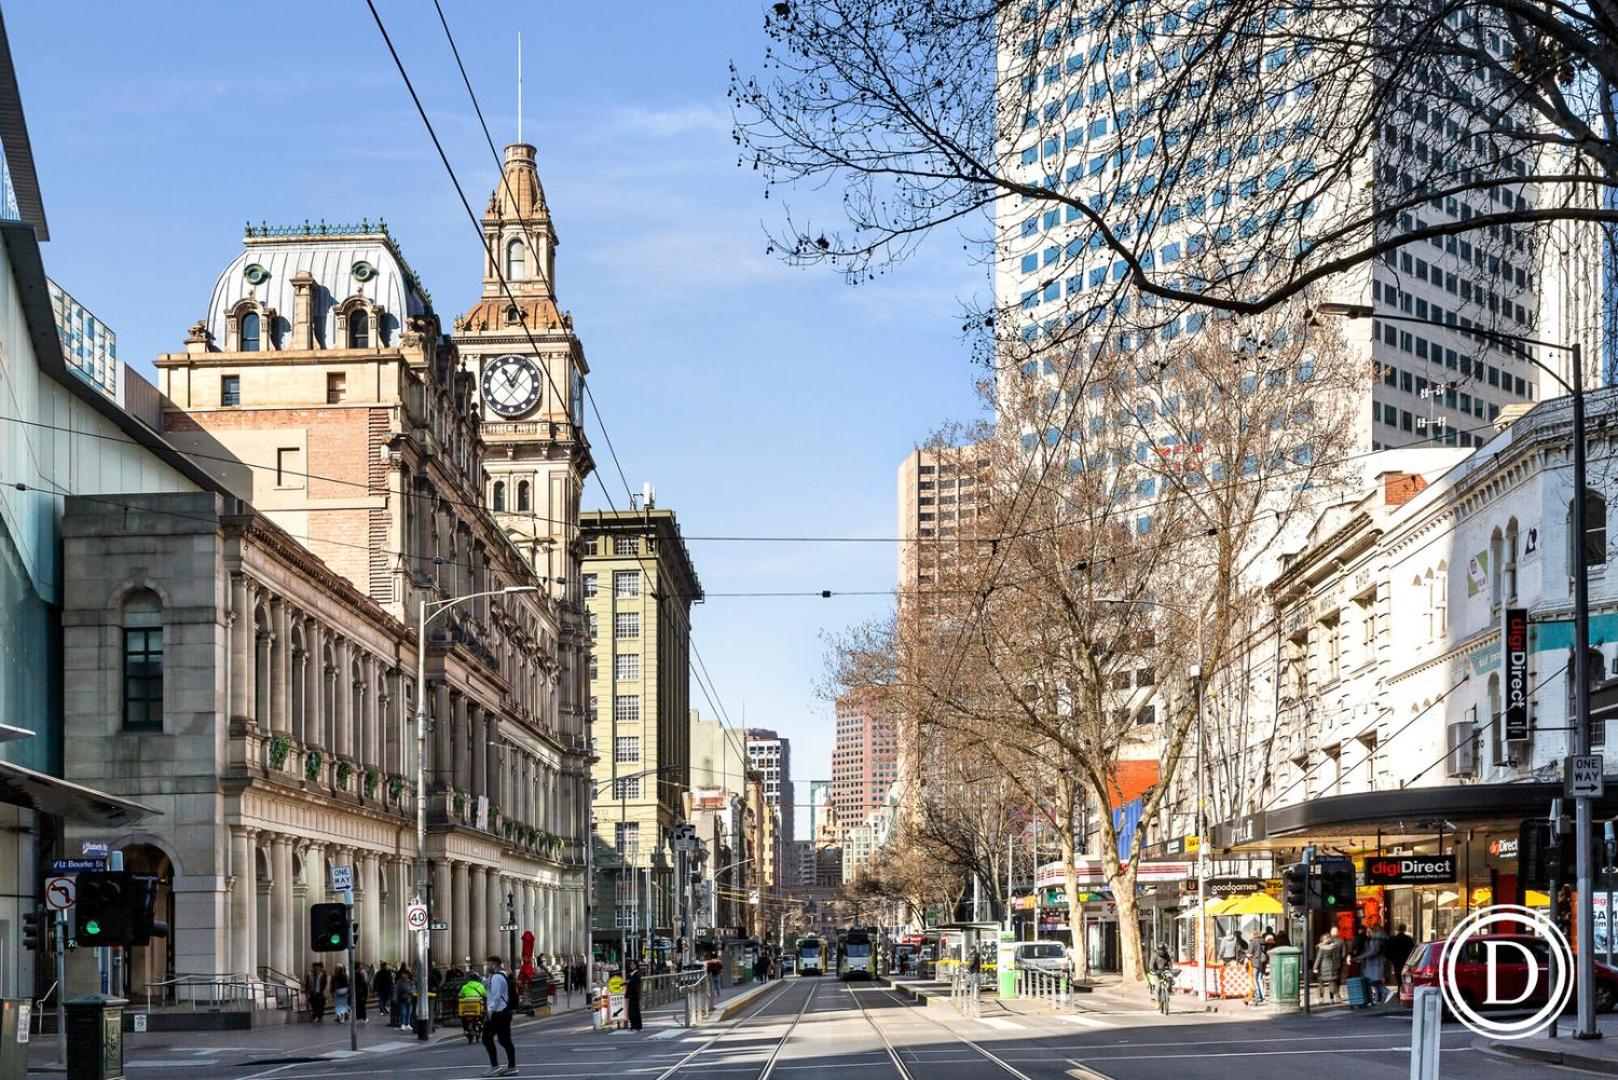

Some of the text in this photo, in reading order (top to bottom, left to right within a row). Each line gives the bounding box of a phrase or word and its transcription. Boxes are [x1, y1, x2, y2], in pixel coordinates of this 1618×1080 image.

[1508, 617, 1526, 709] digiDirect
[1576, 759, 1598, 769] ONE
[1574, 772, 1599, 781] WAY
[68, 860, 94, 868] Bourke
[96, 860, 104, 868] St
[1371, 860, 1451, 876] digiDirect
[1211, 880, 1258, 894] goodgames
[410, 912, 425, 922] 40
